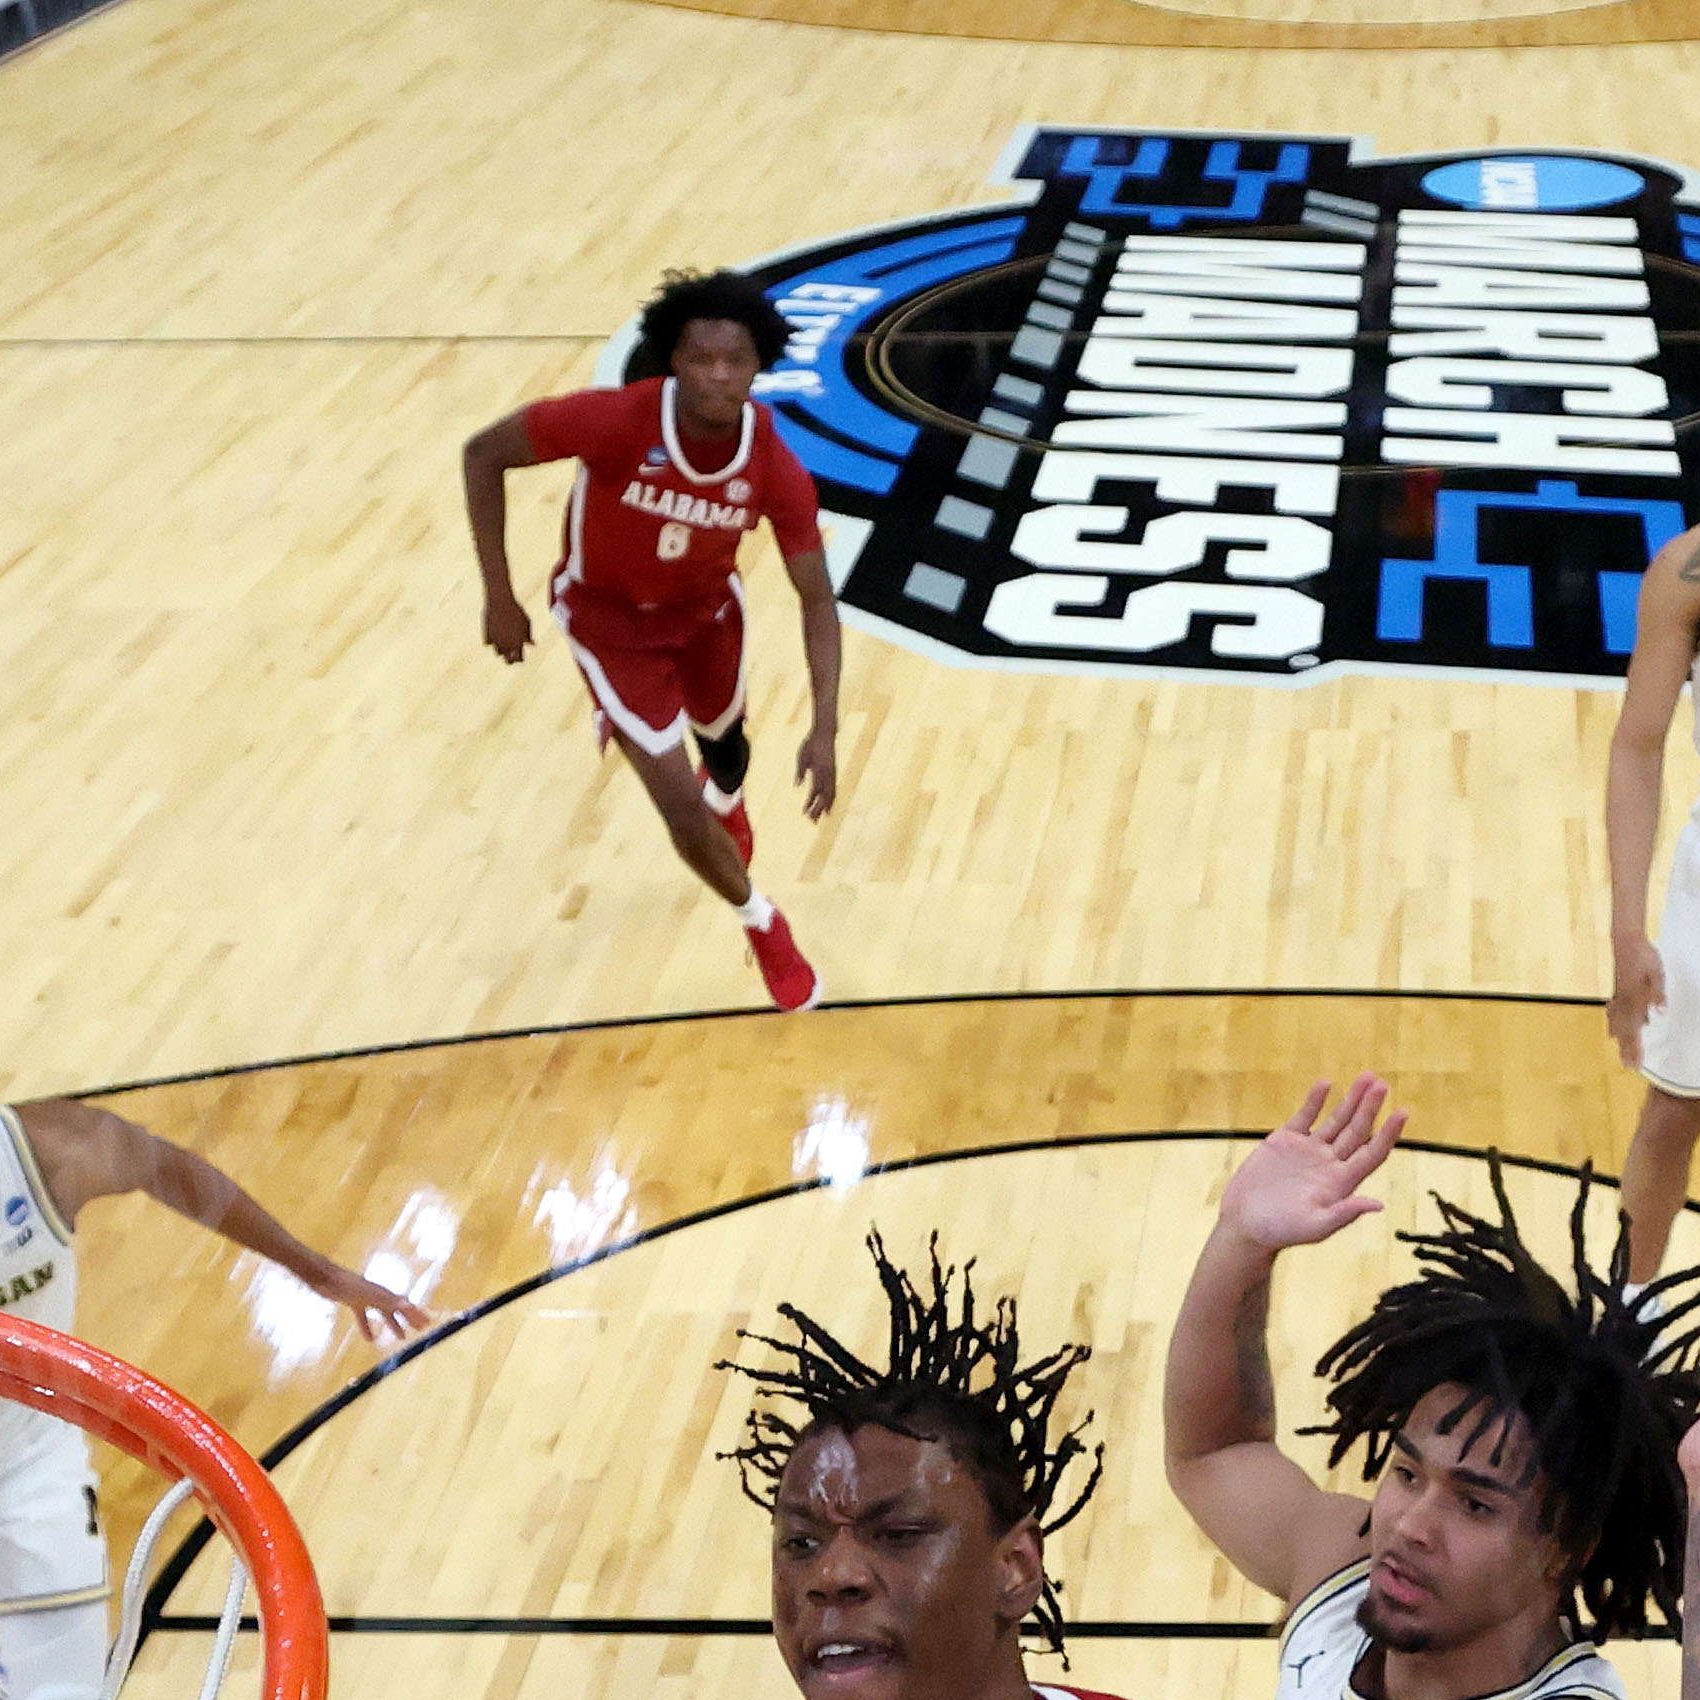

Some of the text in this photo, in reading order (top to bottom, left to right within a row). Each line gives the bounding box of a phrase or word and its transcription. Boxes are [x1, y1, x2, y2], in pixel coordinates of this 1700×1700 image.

[983, 234, 1368, 658] MADNESS
[1380, 207, 1681, 478] MARCH
[620, 480, 748, 530] ALABAMA
